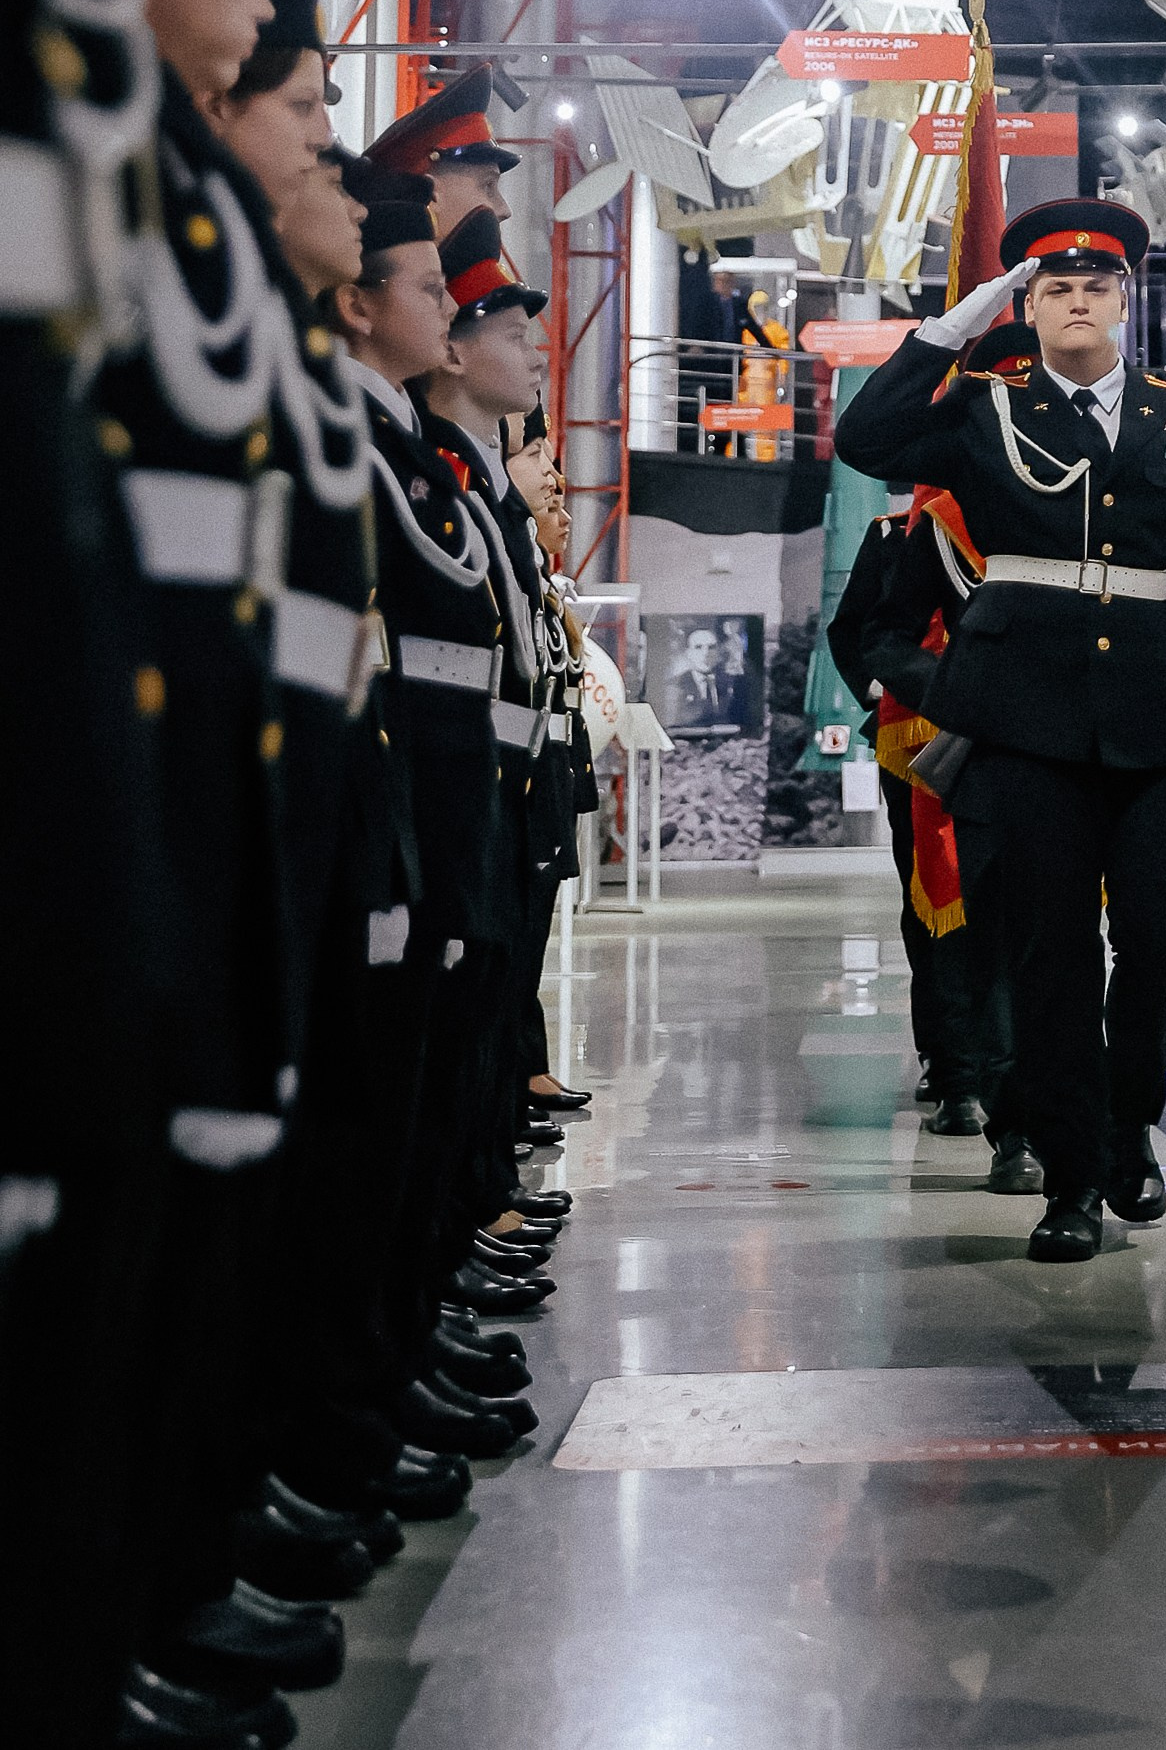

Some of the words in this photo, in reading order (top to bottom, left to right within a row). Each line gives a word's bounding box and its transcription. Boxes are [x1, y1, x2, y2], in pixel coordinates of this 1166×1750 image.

[804, 37, 830, 47] ИСЗ
[833, 37, 919, 49] «РЕСУРС-ДК»
[854, 52, 899, 61] SATELLITE
[804, 62, 836, 71] 2006
